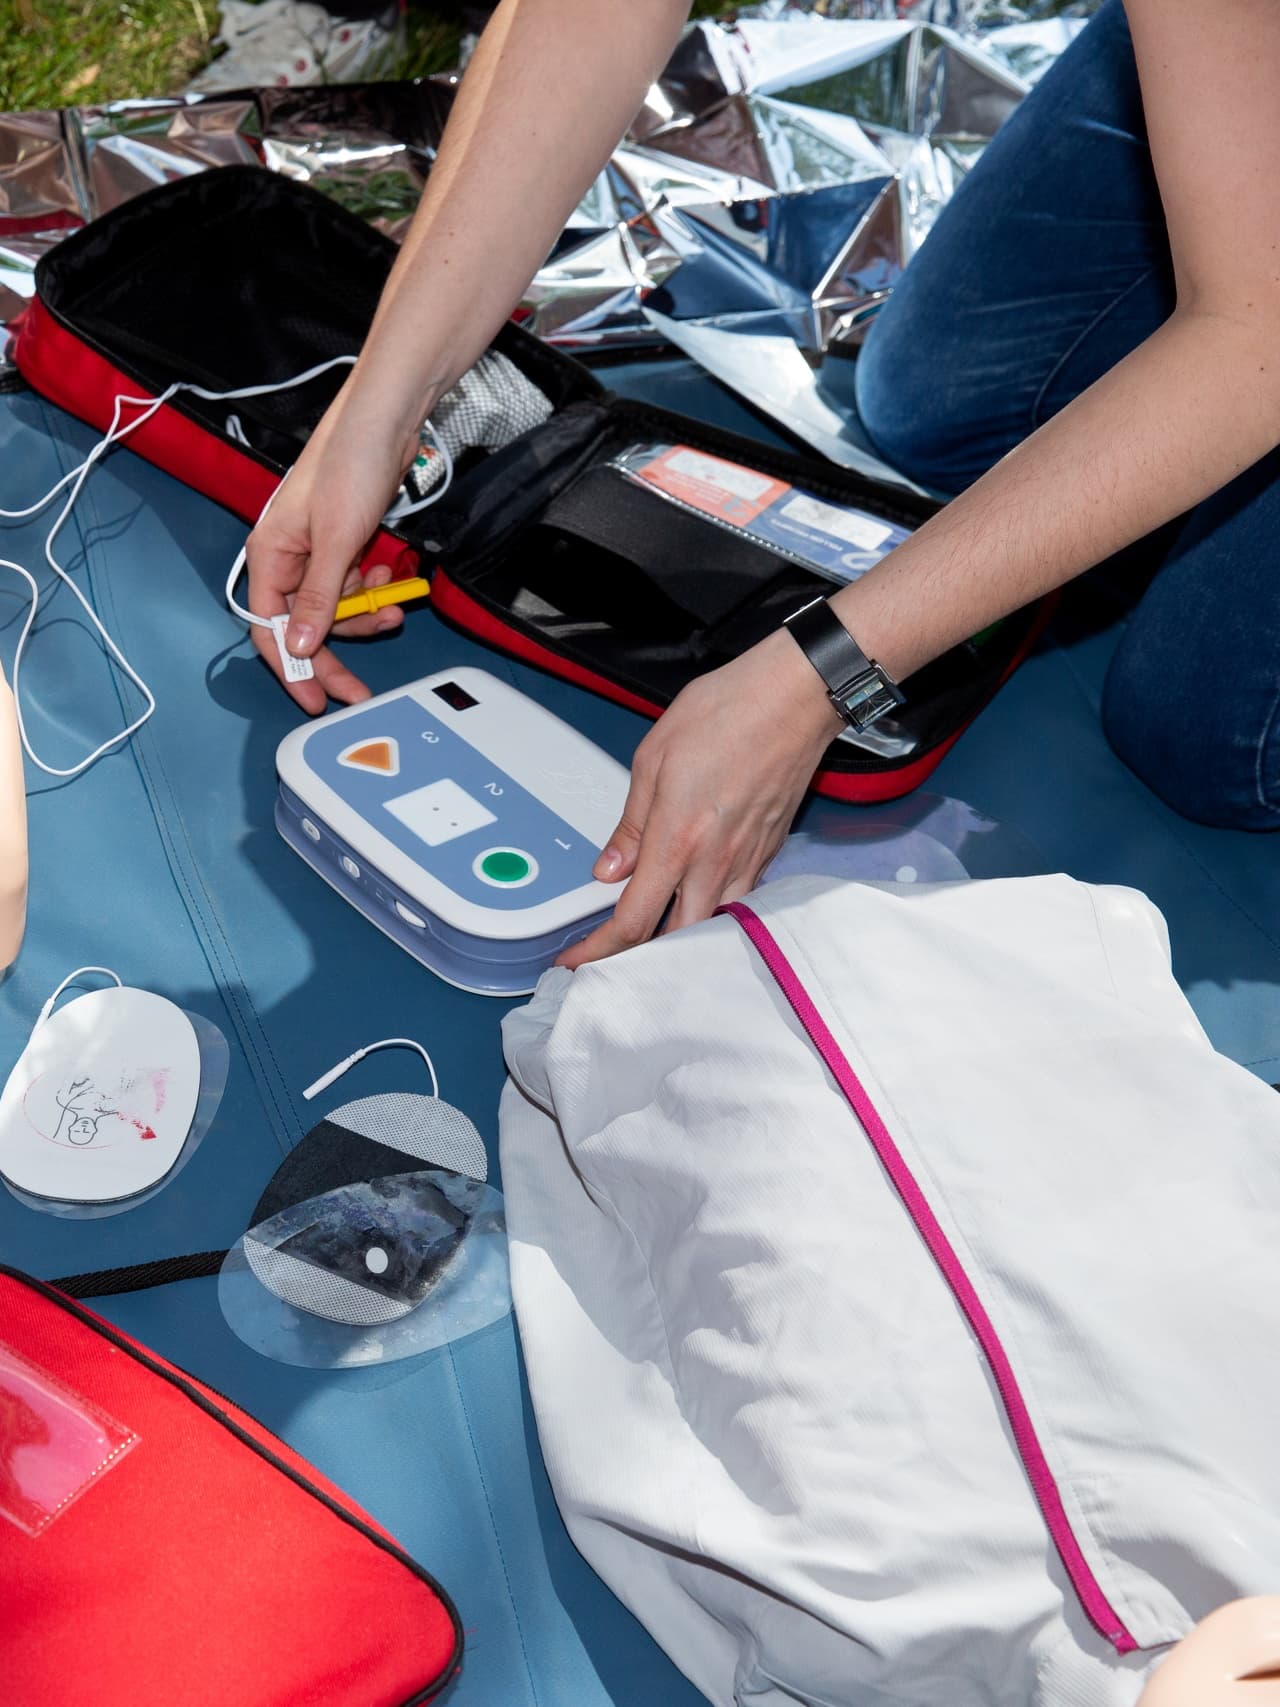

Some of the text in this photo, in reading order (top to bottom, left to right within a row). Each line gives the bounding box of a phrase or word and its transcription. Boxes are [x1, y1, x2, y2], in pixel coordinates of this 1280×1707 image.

[421, 731, 440, 744] 3
[483, 782, 504, 796] 2
[554, 838, 571, 850] 1
